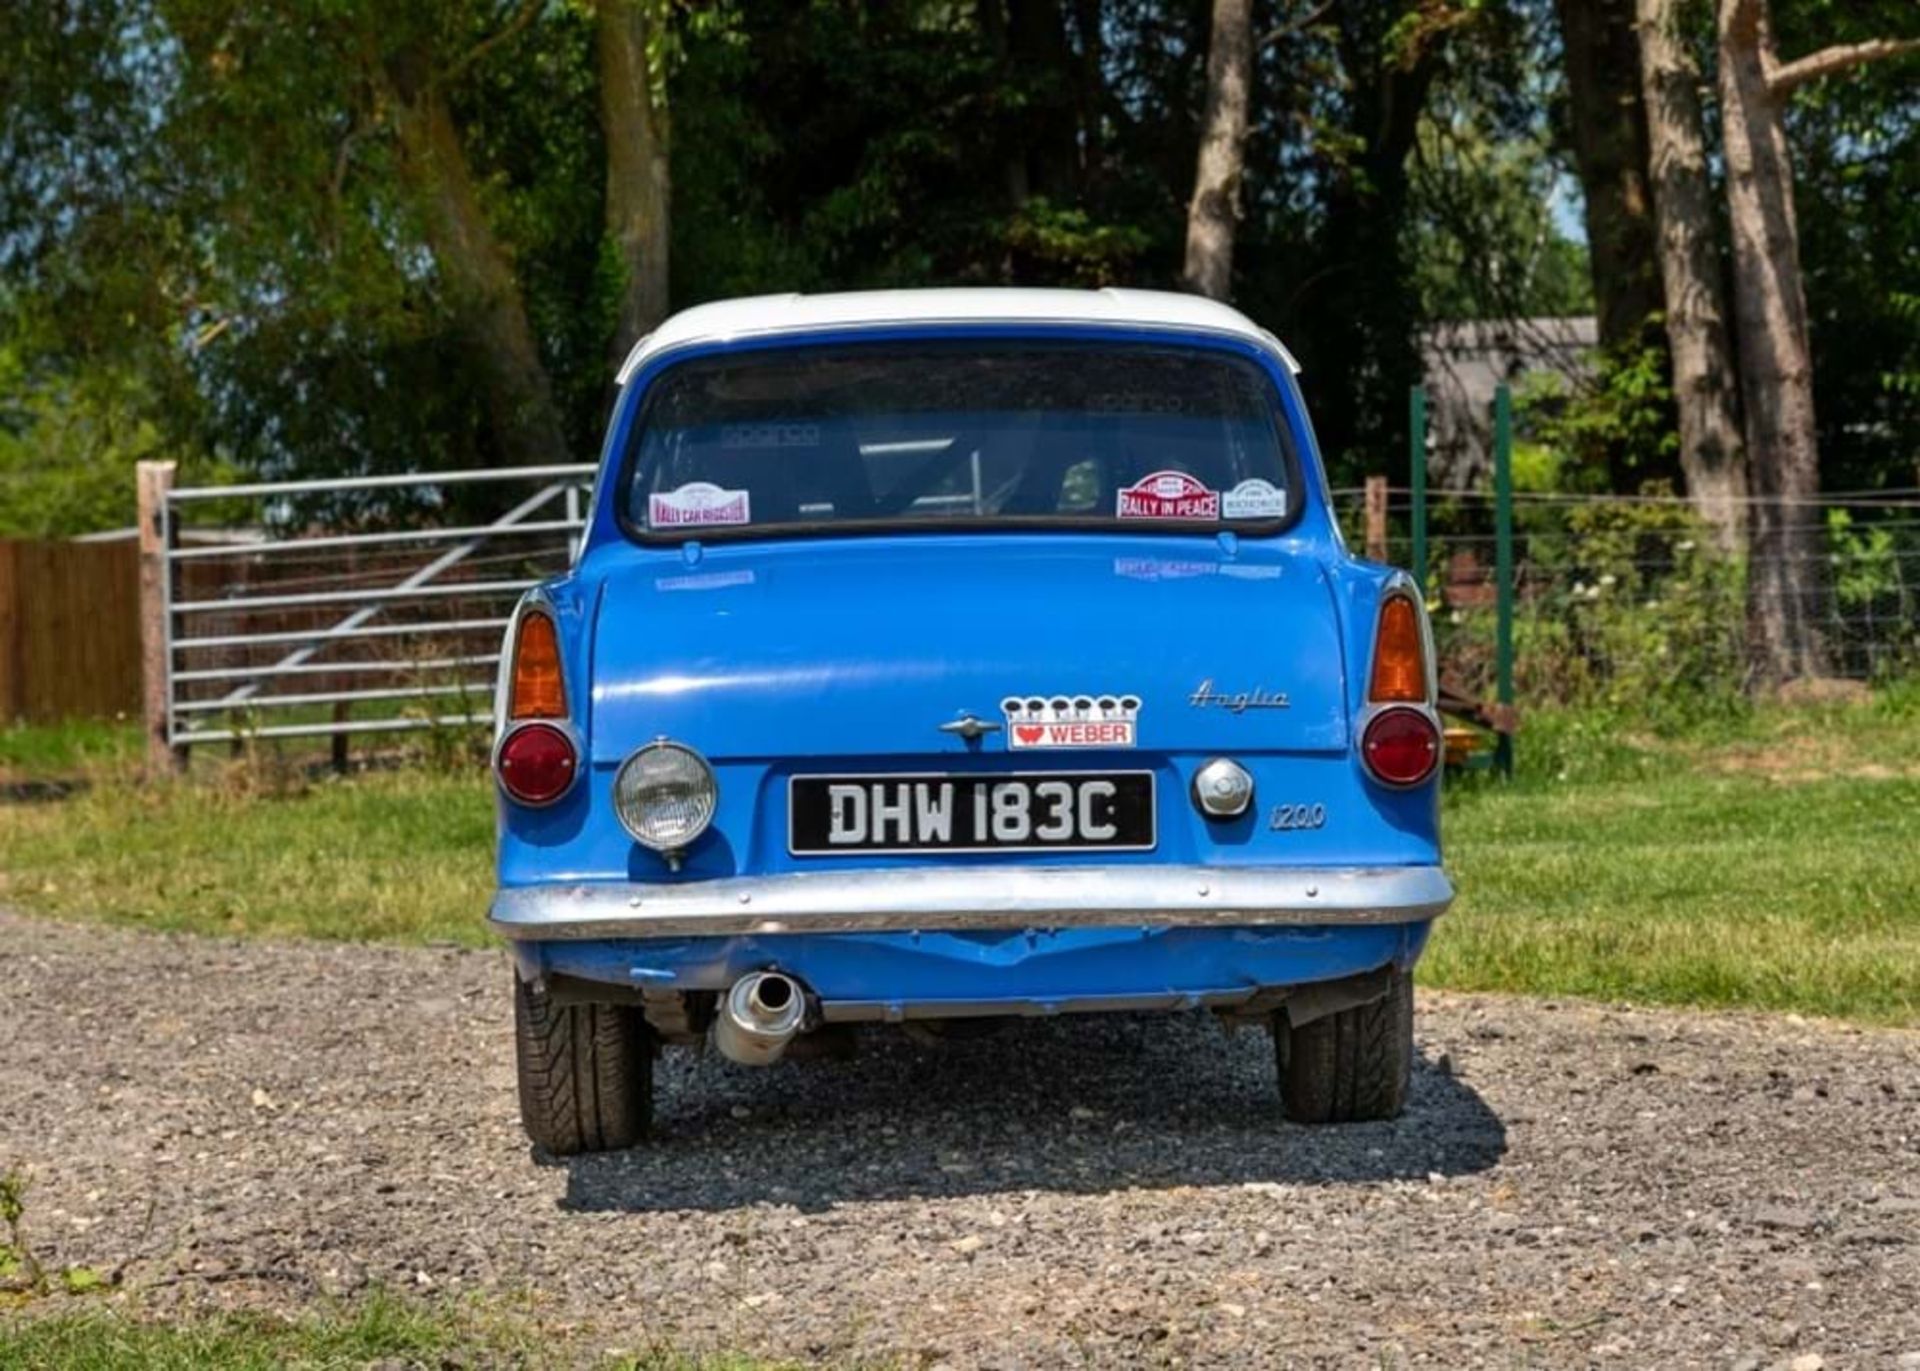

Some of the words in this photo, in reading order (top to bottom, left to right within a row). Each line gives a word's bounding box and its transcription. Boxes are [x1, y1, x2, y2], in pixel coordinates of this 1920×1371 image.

[1121, 495, 1159, 516] RALLY
[1161, 500, 1175, 516] IN
[1177, 496, 1218, 517] PEACE
[1189, 678, 1290, 711] Anglia
[1049, 725, 1128, 743] WEBER
[829, 783, 953, 843] DHW
[974, 781, 1117, 841] 183C
[1271, 803, 1324, 829] 1200
